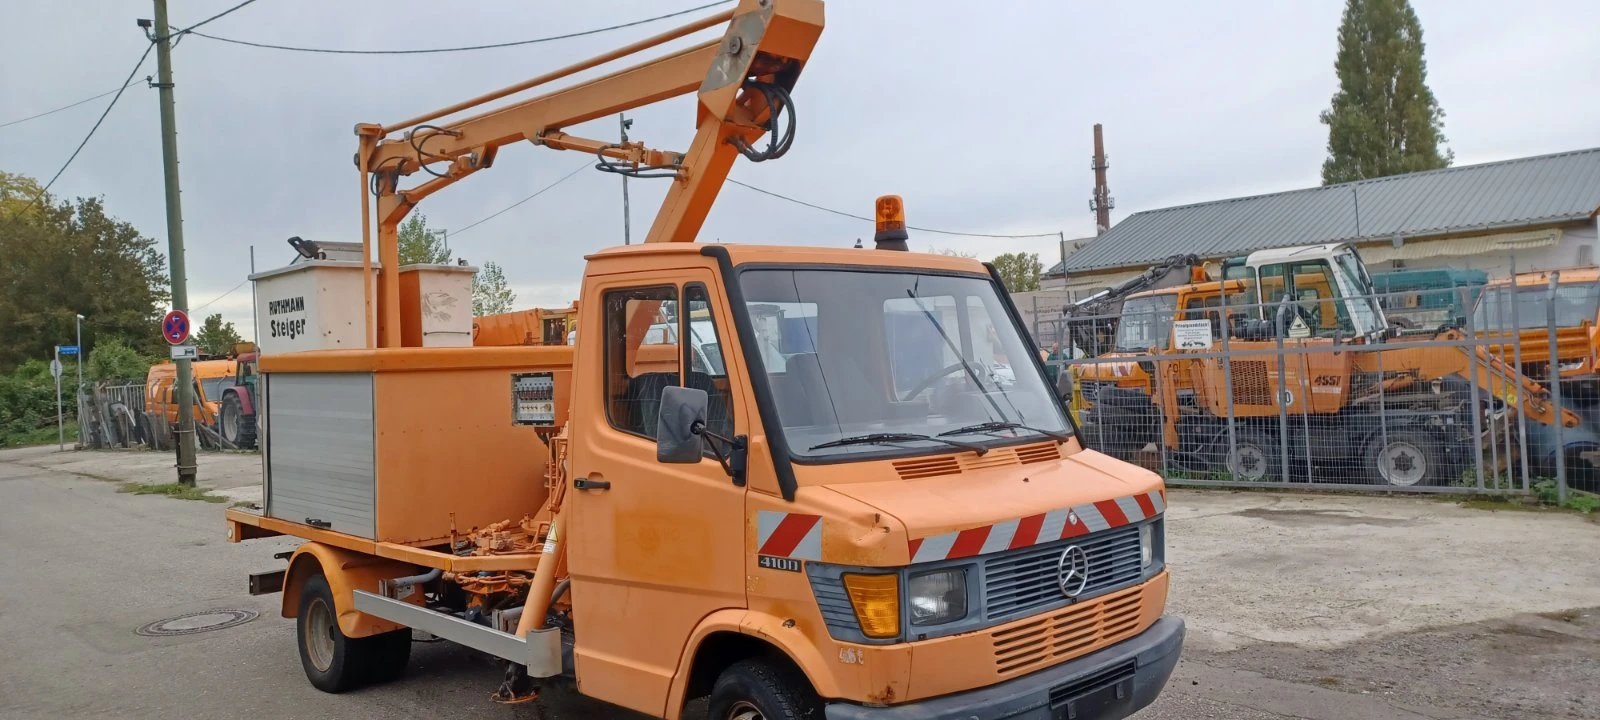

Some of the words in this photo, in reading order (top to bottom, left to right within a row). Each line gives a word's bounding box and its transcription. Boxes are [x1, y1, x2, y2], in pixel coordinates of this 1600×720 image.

[269, 296, 304, 316] RUTHMANN
[270, 317, 306, 340] Steiger
[760, 555, 798, 571] 410D
